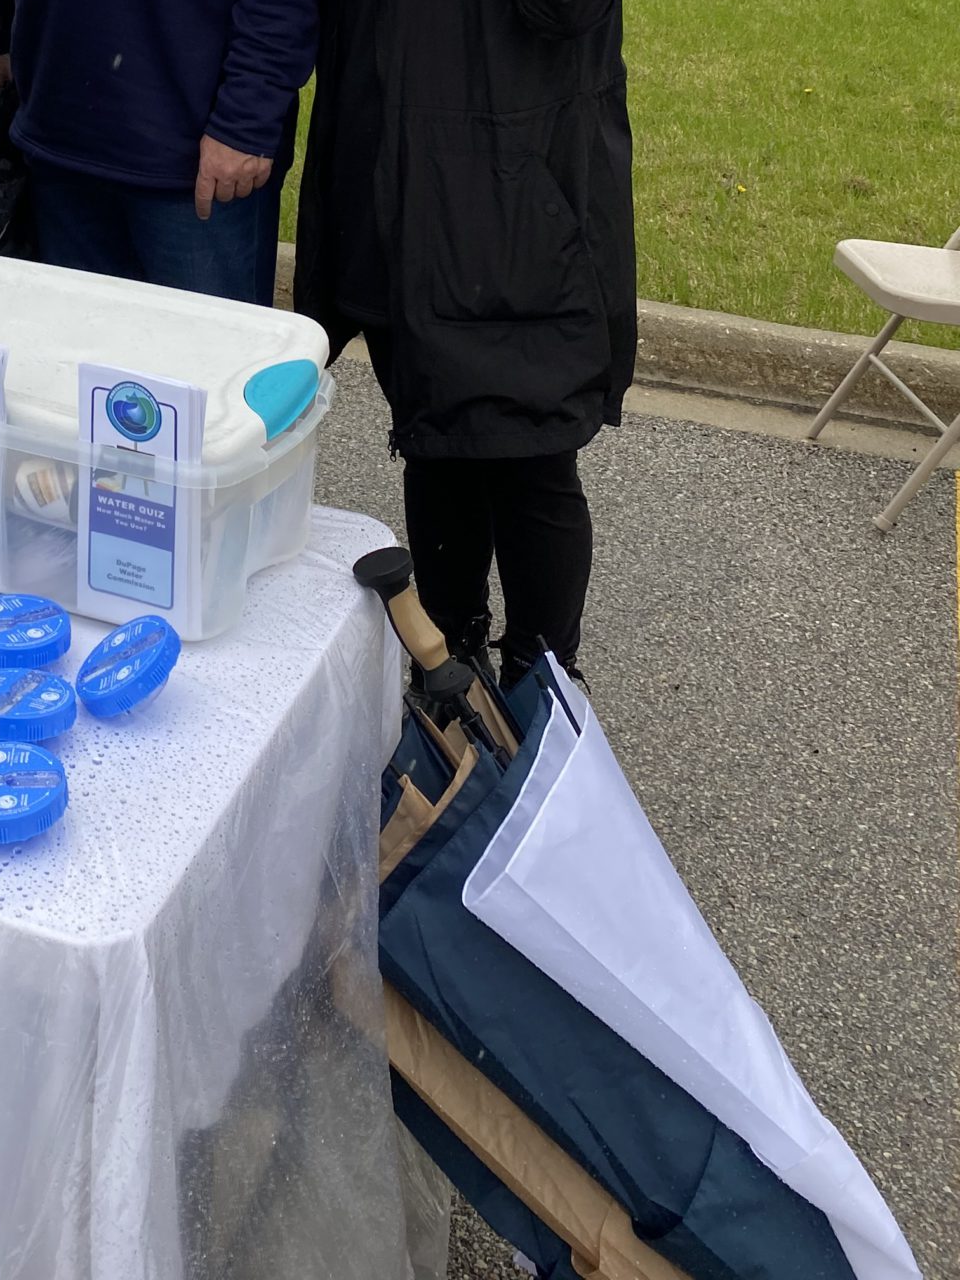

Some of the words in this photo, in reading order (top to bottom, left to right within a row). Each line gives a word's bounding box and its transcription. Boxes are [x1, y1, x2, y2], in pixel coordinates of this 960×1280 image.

[97, 495, 135, 512] WATER
[139, 504, 165, 520] QUIZ
[116, 559, 146, 573] DuPage
[119, 567, 143, 580] Water
[106, 573, 155, 591] Commission
